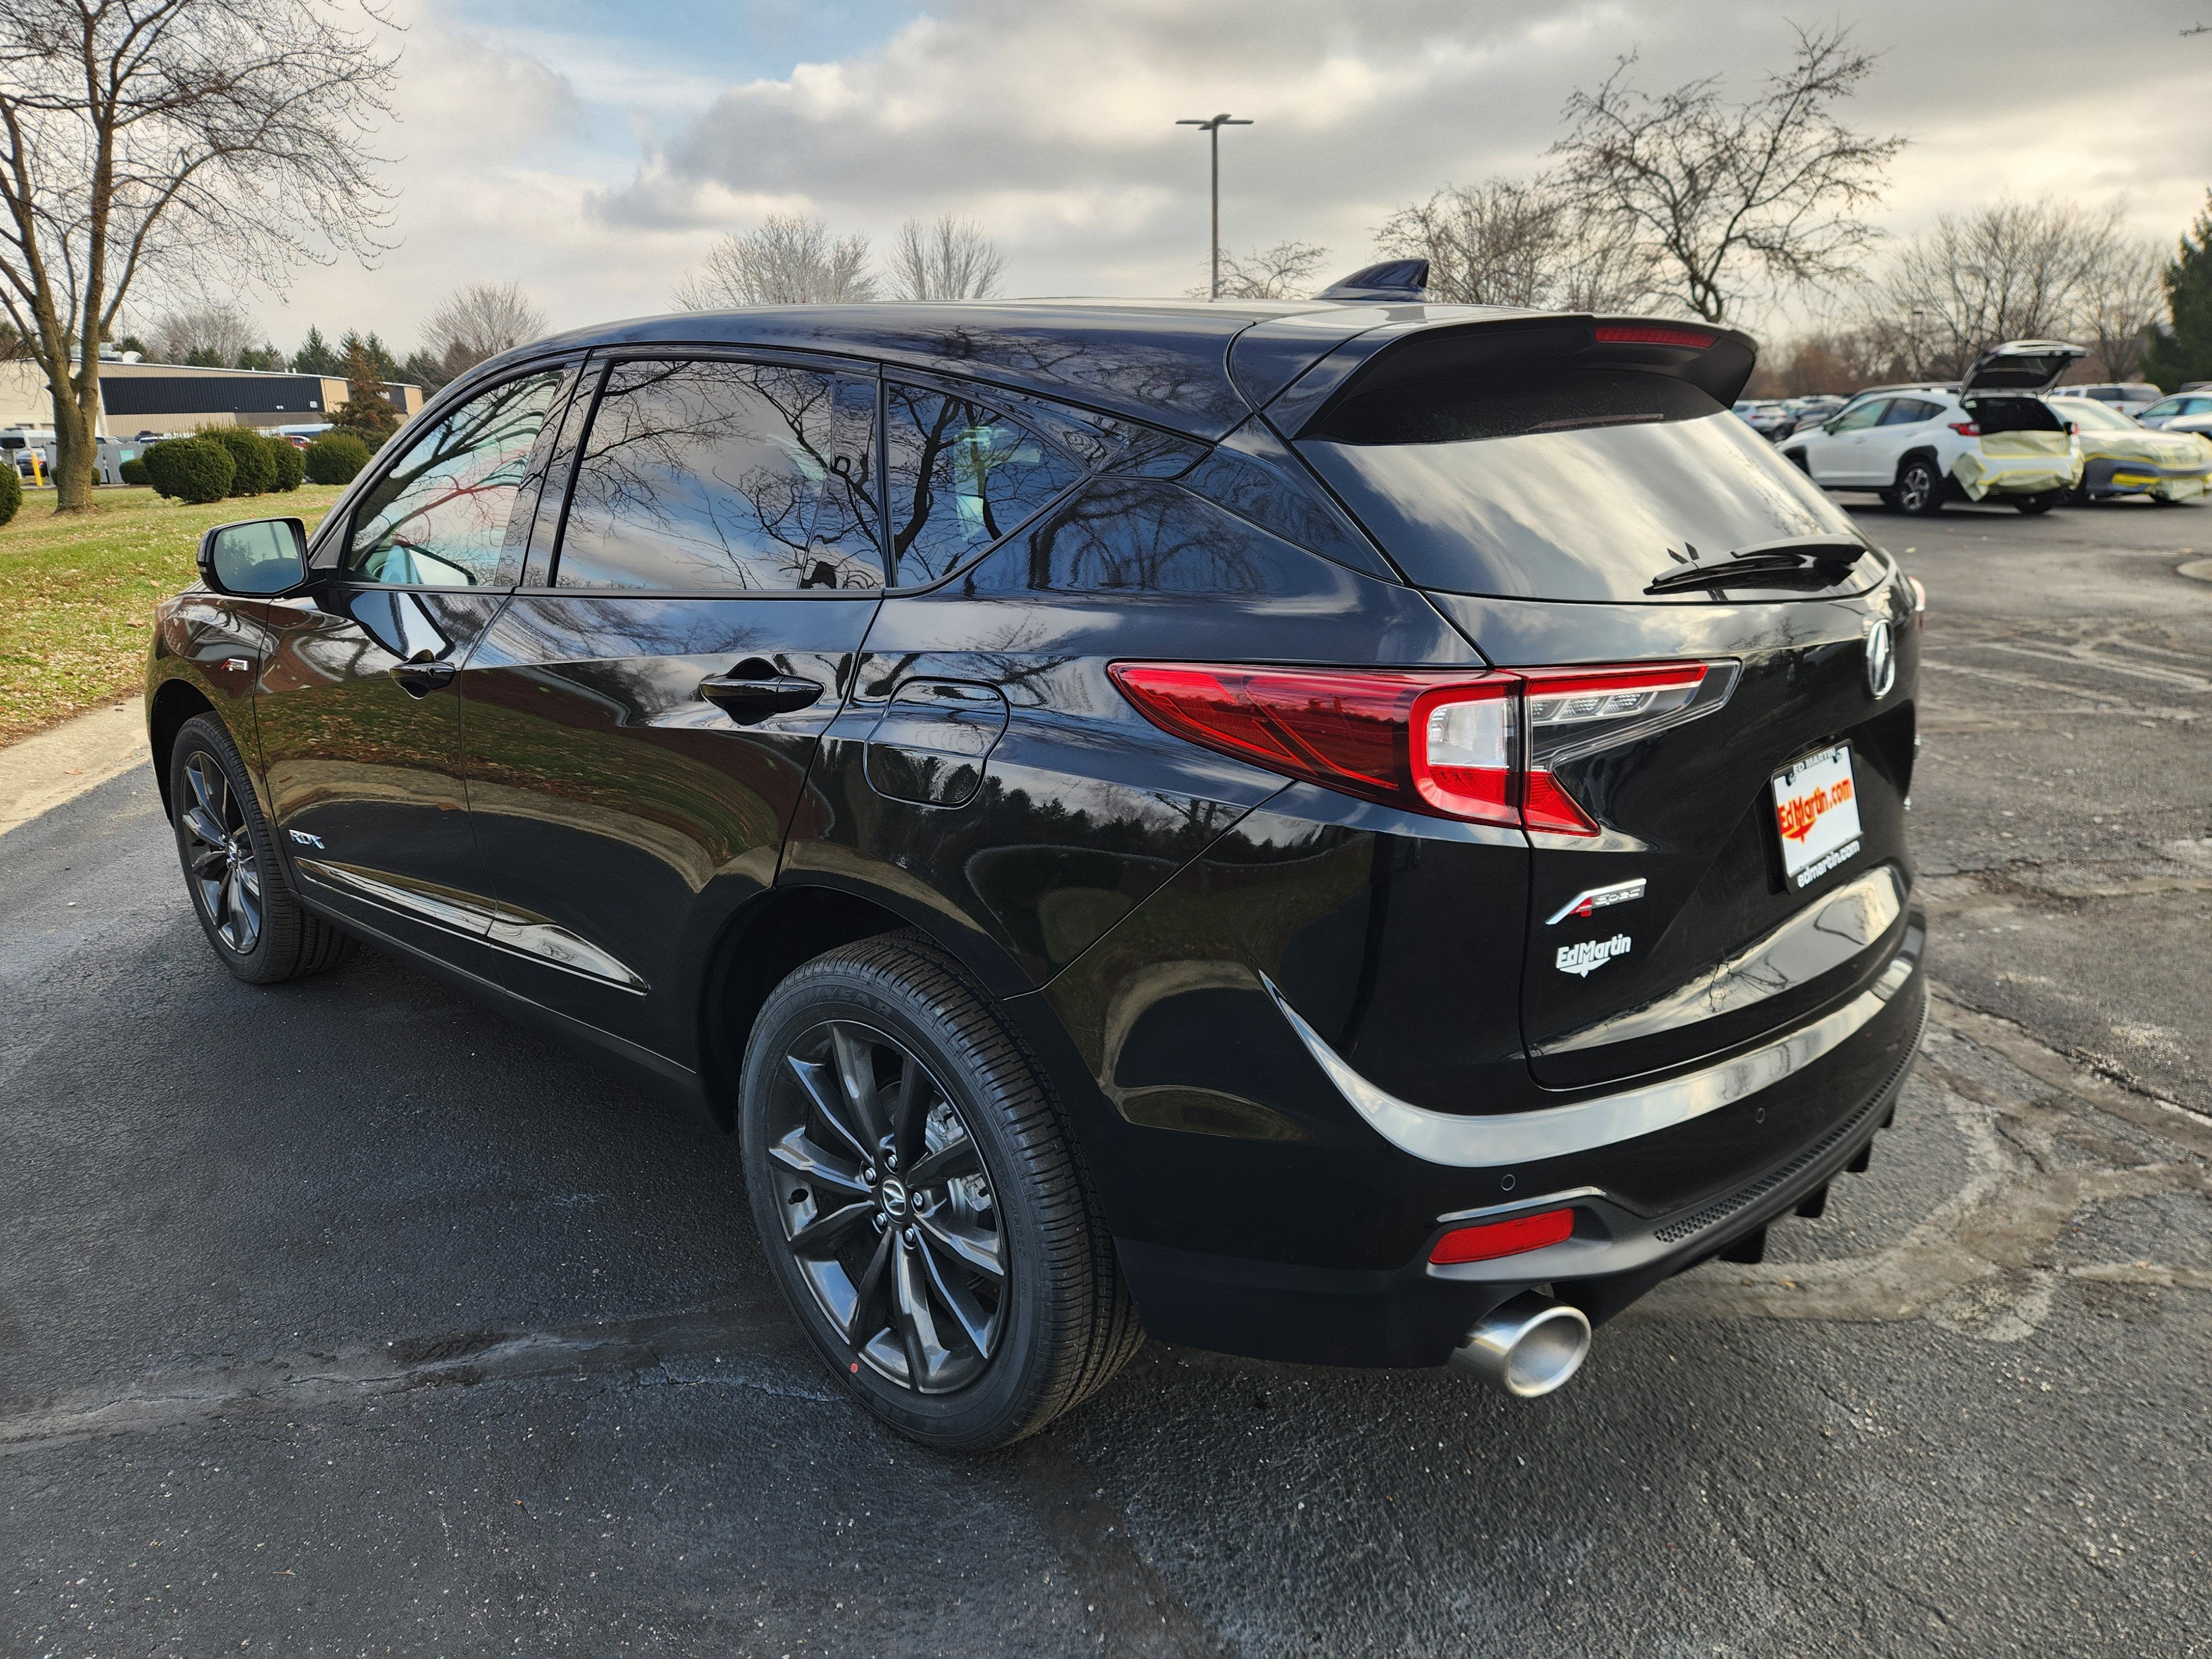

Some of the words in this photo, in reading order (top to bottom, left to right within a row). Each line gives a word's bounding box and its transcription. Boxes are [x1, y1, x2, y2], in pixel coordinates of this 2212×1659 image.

[1793, 761, 1805, 774] ED
[1805, 747, 1837, 769] MARTIN
[1777, 779, 1854, 833] EdMartin.com
[1797, 841, 1860, 888] edmartin.com
[1556, 933, 1632, 969] EdMartin
